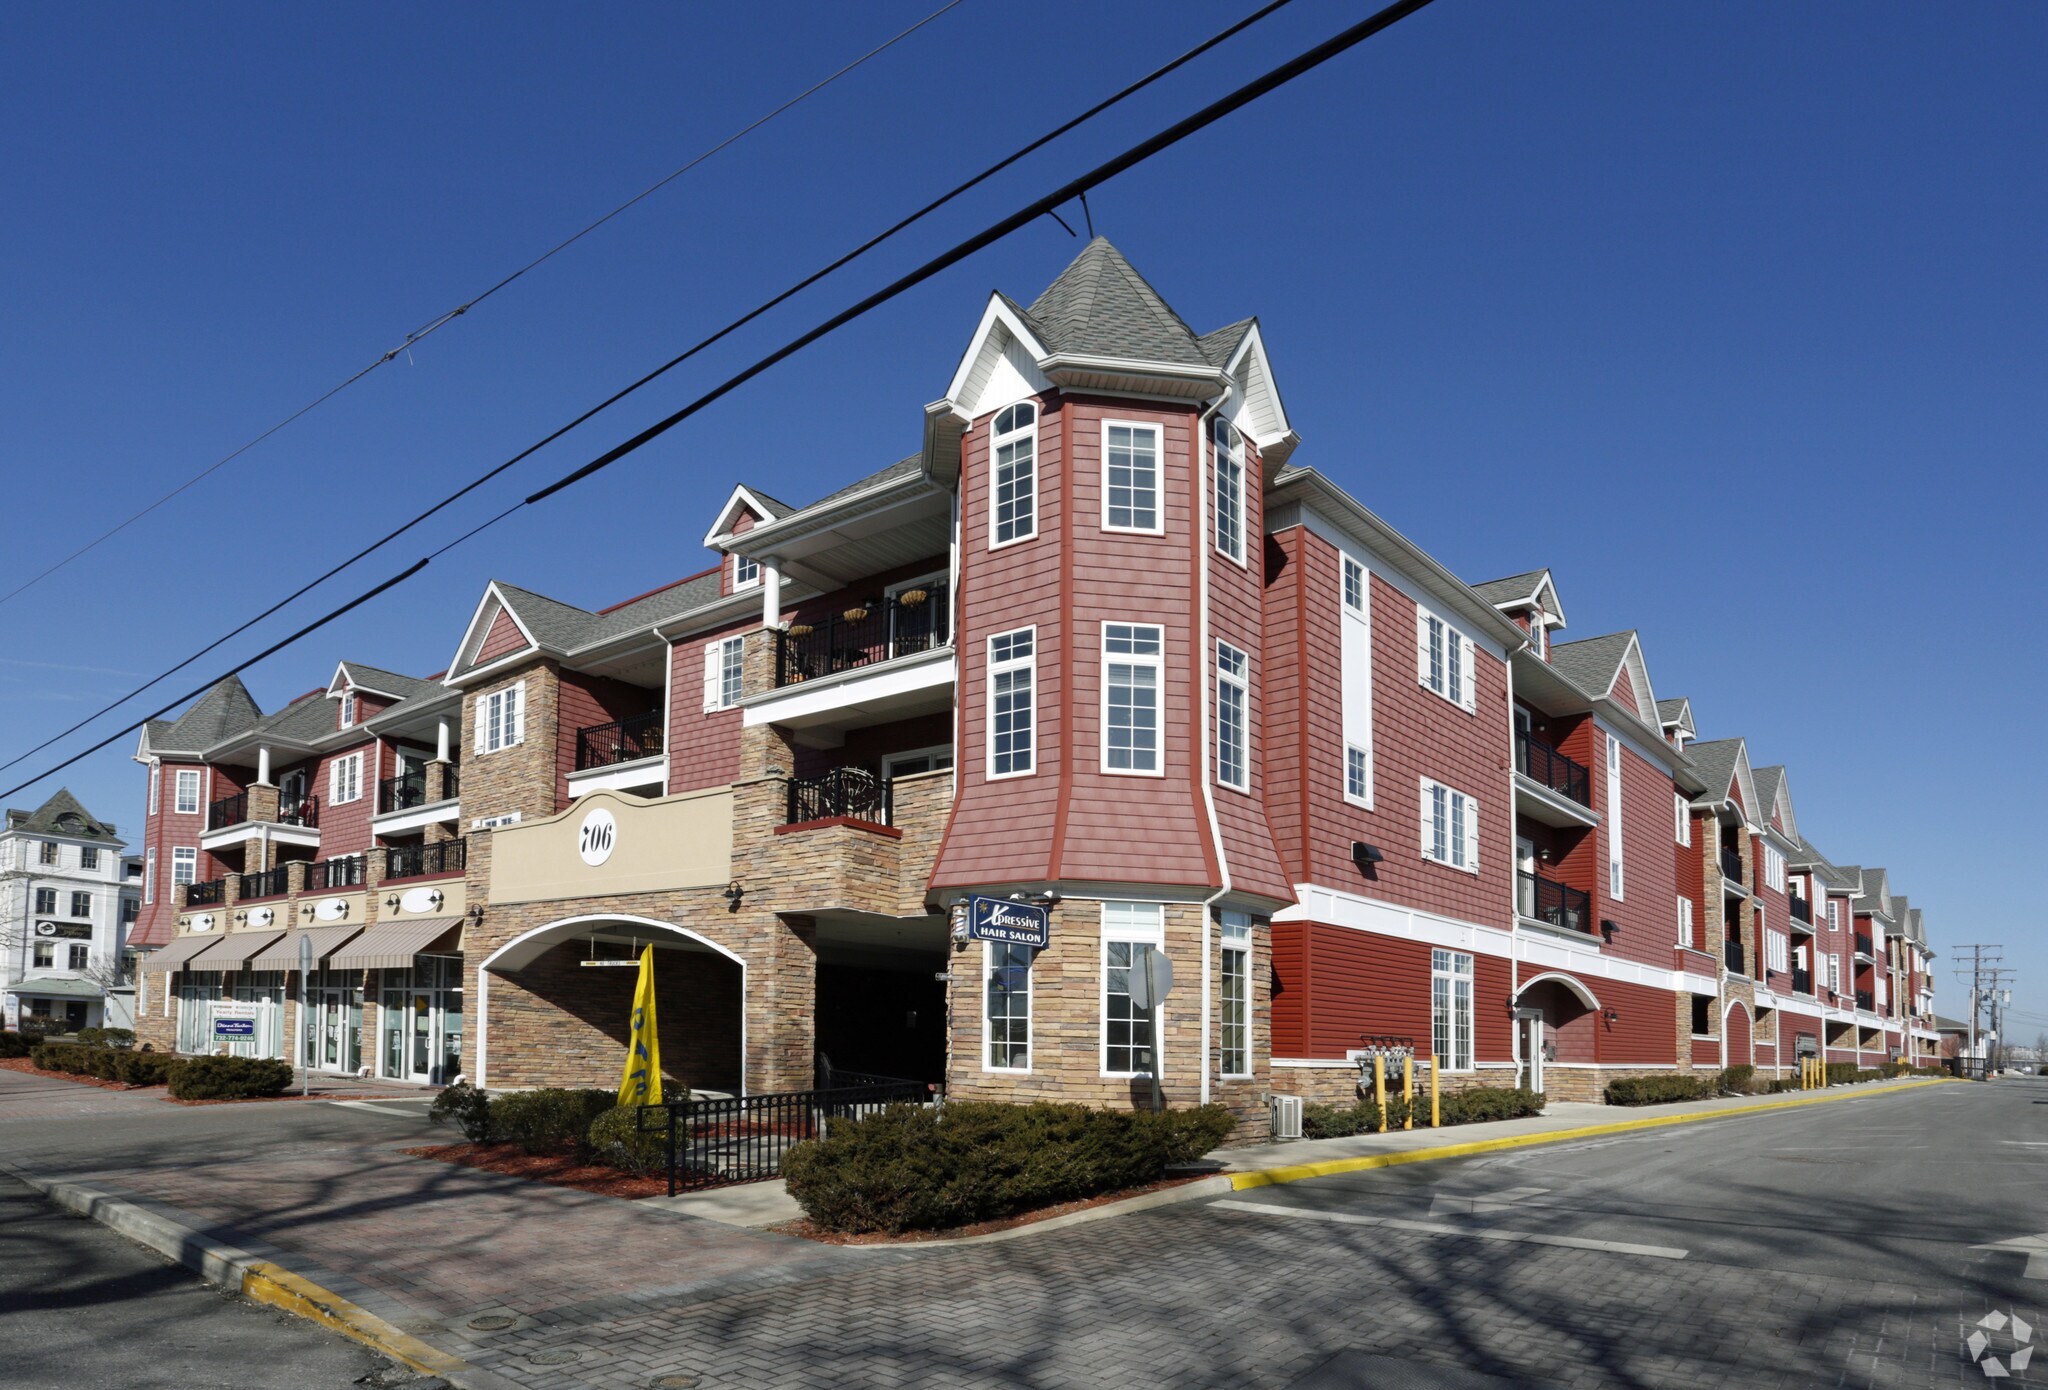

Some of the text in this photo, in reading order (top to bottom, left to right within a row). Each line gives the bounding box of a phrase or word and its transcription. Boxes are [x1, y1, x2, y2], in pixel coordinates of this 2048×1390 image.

[582, 822, 612, 853] 706
[980, 927, 1041, 943] HAIR SALON
